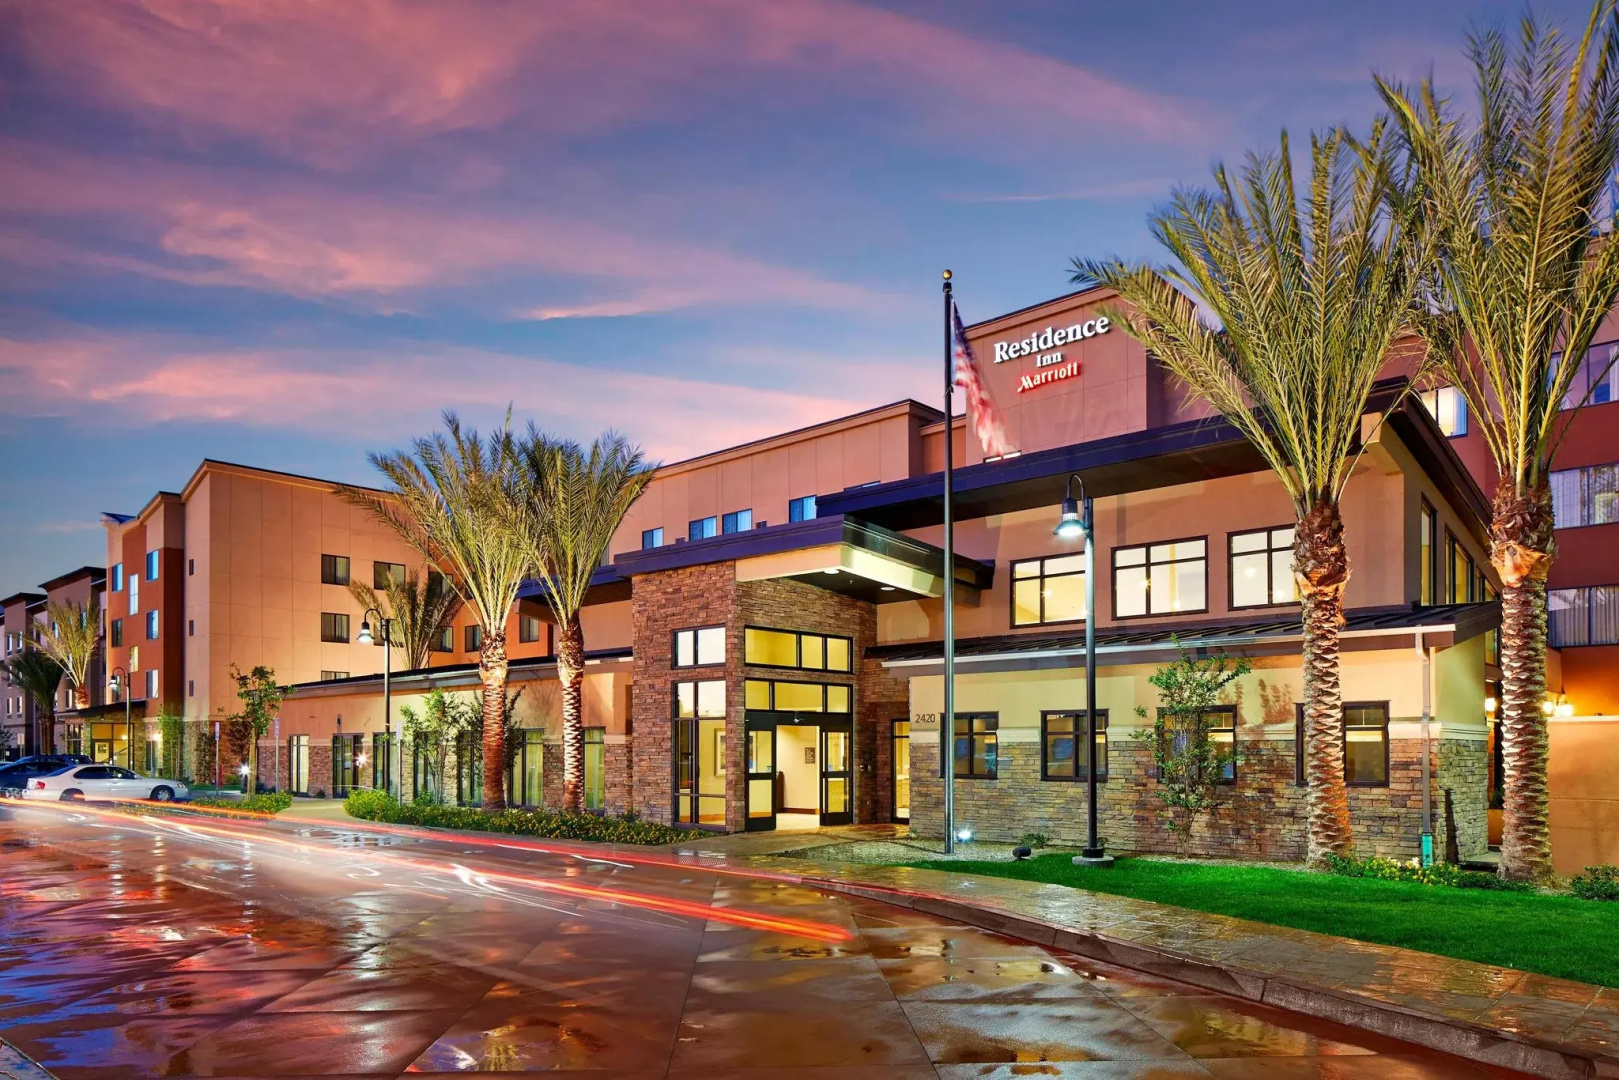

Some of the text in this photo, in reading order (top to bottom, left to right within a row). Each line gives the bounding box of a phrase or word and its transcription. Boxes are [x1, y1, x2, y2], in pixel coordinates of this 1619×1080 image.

[993, 316, 1110, 363] Residence
[1036, 352, 1062, 367] Inn
[1017, 361, 1078, 392] Marriott
[915, 713, 936, 723] 2420
